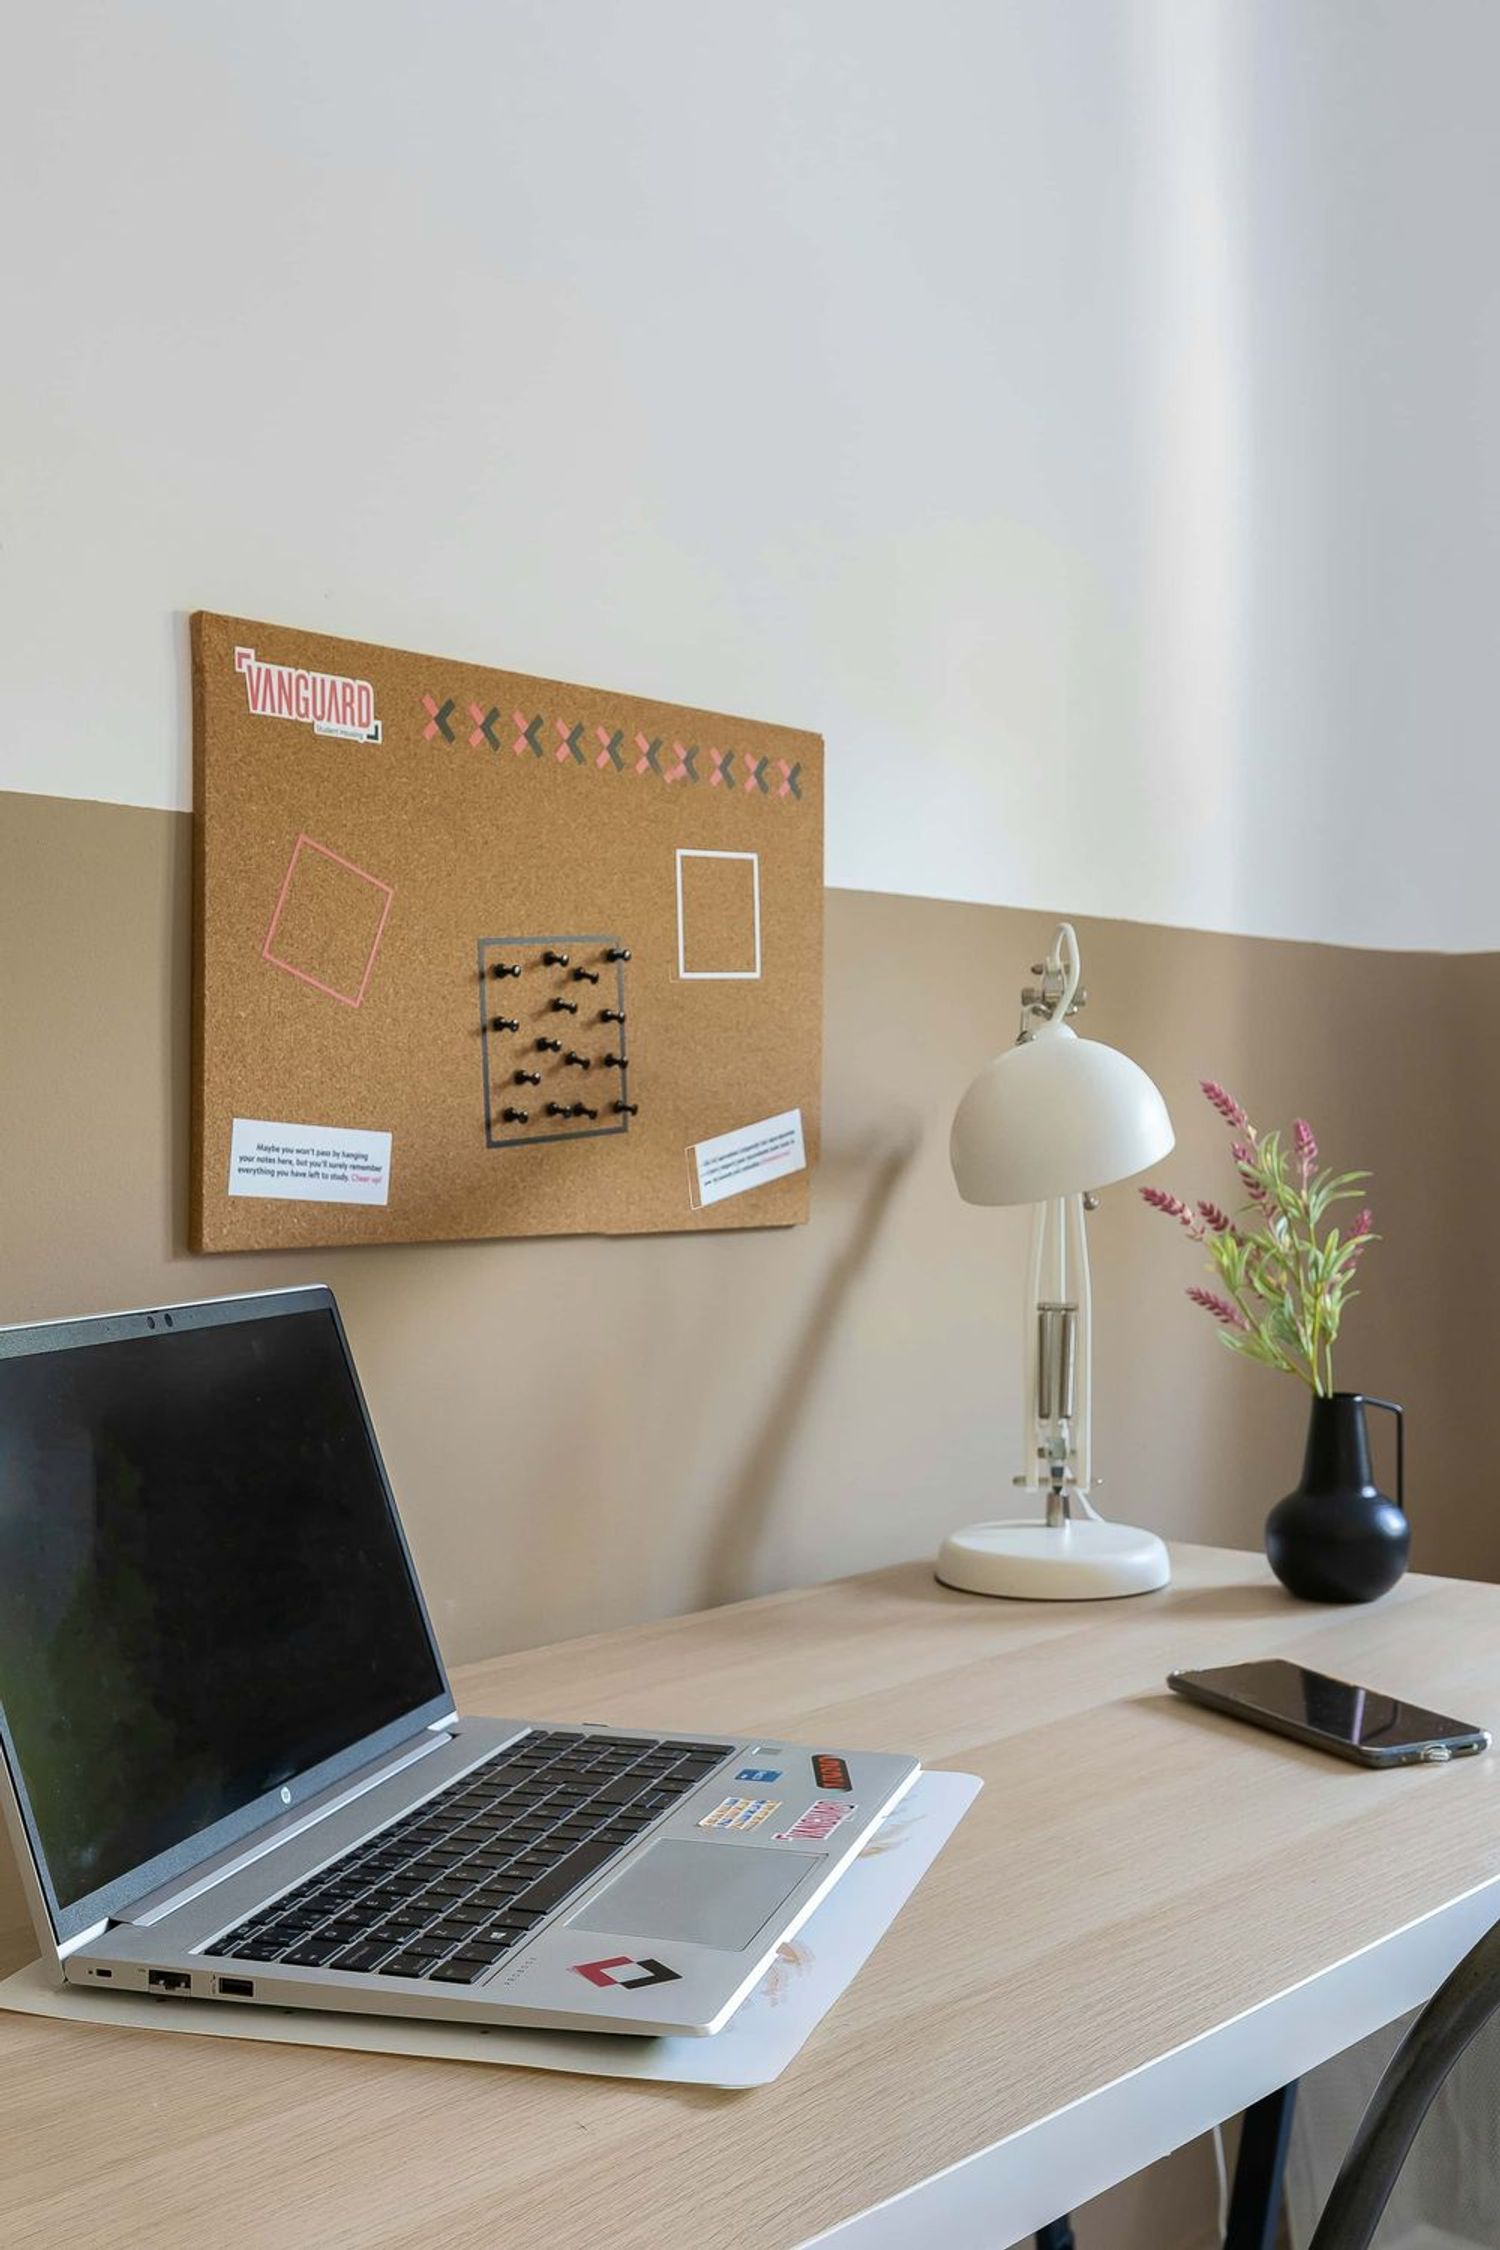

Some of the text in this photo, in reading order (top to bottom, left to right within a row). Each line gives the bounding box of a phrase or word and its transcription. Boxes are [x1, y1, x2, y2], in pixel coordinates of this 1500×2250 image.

[247, 664, 371, 729] VANGUARD
[256, 1143, 369, 1161] Maybe you won't pass by hanging
[256, 1156, 276, 1164] notes
[295, 1158, 308, 1166] but
[328, 1162, 348, 1171] surely
[349, 1164, 383, 1172] remember
[237, 1167, 276, 1177] everything
[276, 1170, 289, 1178] you
[290, 1168, 307, 1178] have
[307, 1170, 320, 1179] left
[321, 1172, 330, 1180] to
